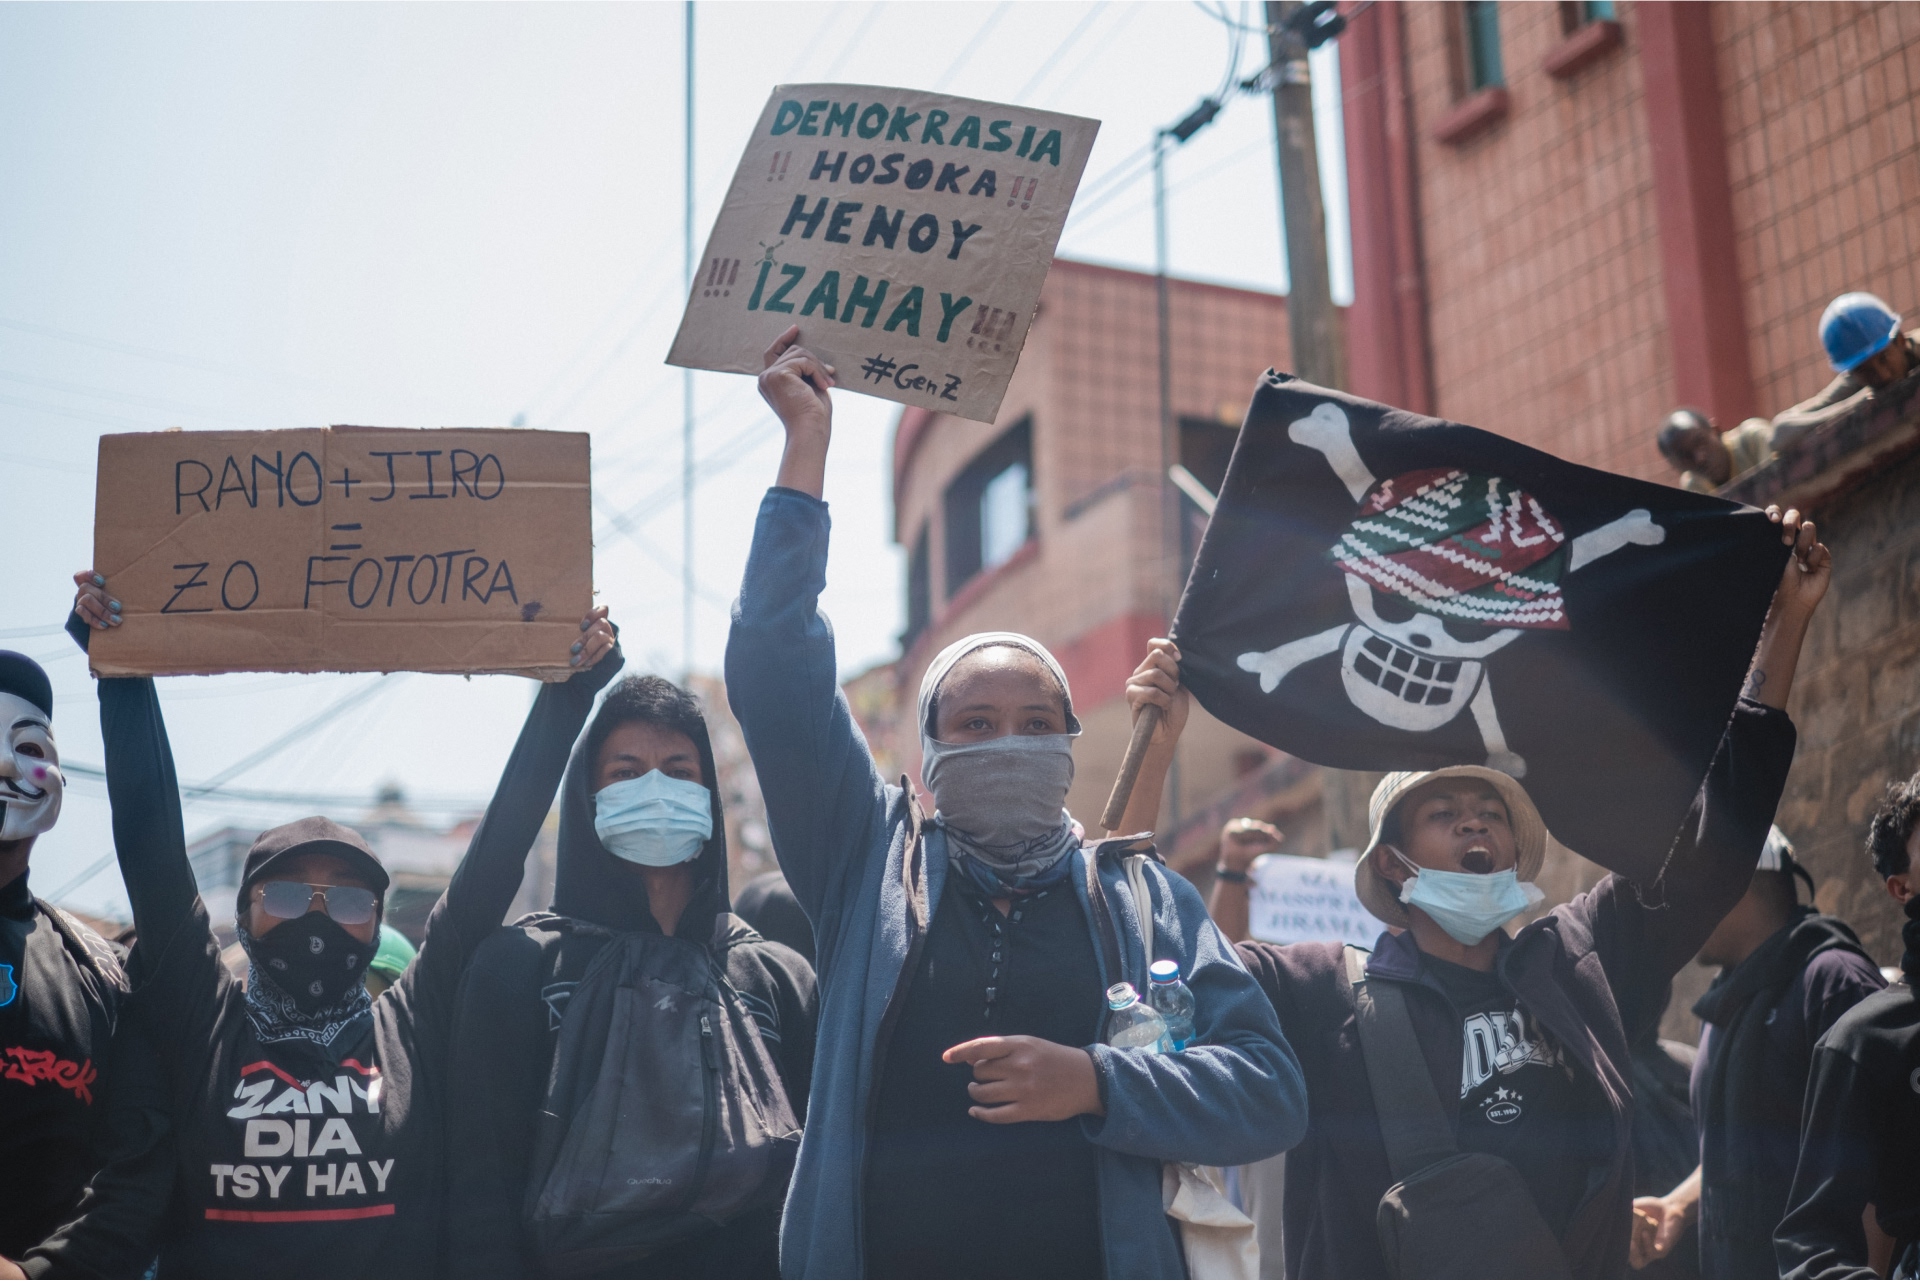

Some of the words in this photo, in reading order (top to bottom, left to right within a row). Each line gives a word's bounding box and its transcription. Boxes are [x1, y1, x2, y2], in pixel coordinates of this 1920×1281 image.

[770, 100, 1062, 167] DEMOKRASIA
[809, 150, 997, 198] HOSOKA
[779, 194, 982, 261] HENOY
[161, 560, 260, 615] ZO
[244, 1118, 362, 1157] DIA
[210, 1164, 292, 1199] TSY
[306, 1158, 395, 1197] HAY
